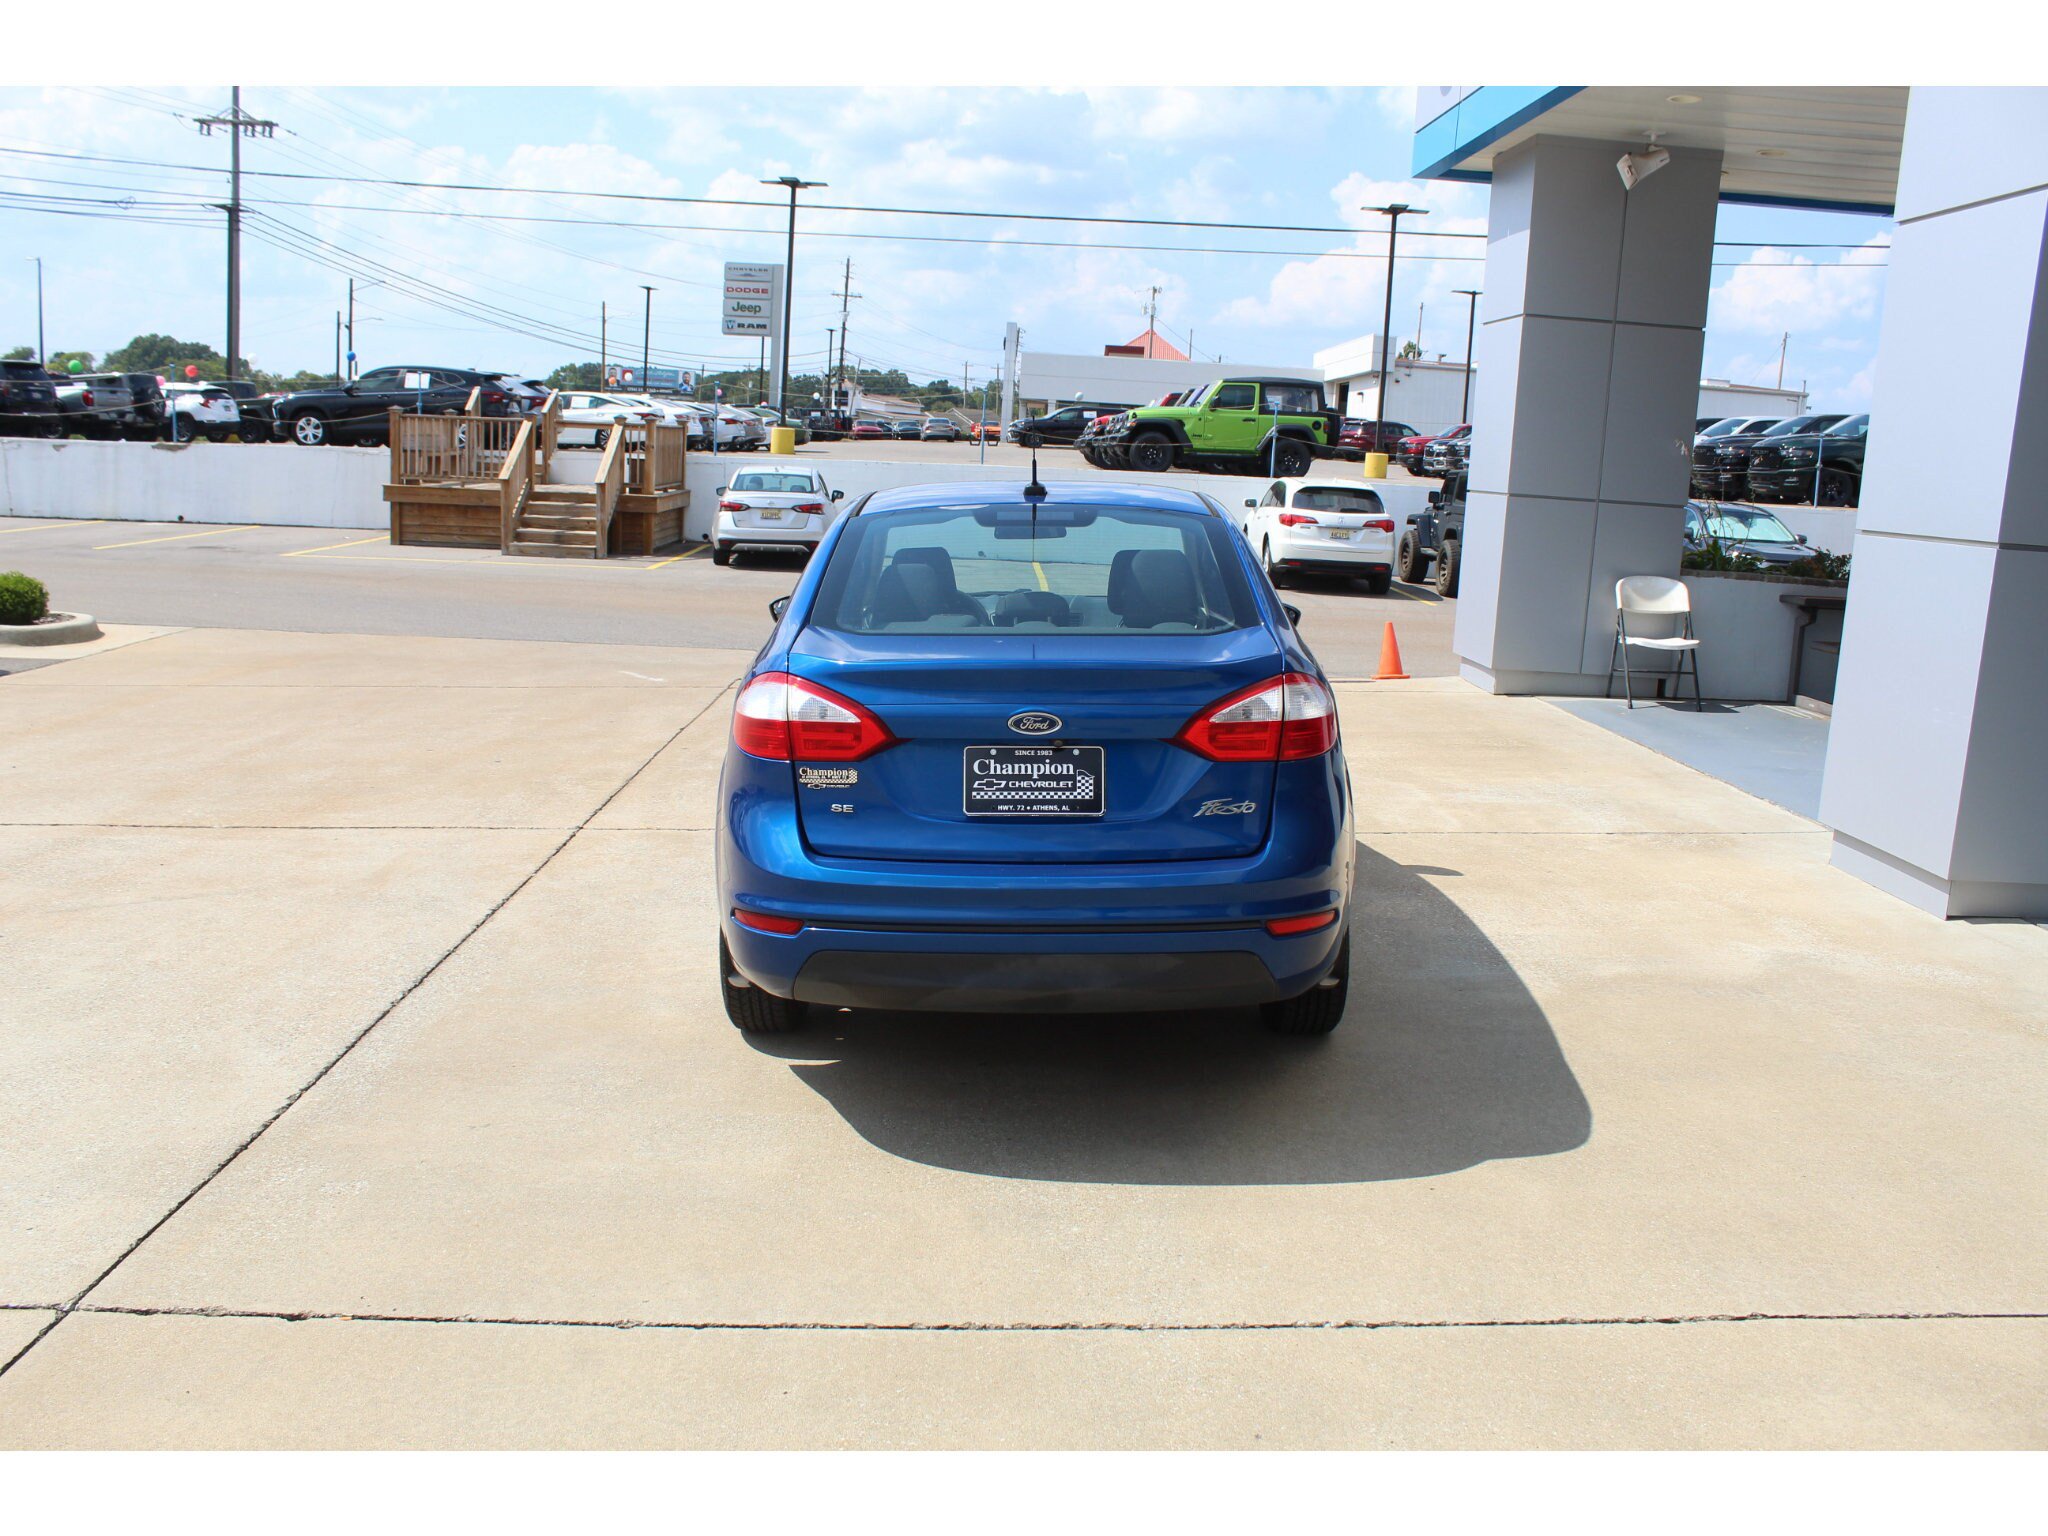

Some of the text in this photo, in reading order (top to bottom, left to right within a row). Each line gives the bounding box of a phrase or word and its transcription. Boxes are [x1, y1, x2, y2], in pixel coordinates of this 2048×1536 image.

[731, 301, 762, 315] Jeep
[1019, 716, 1050, 730] Ford
[799, 766, 849, 778] Champion
[972, 758, 1075, 779] Champion
[1008, 780, 1074, 788] CHEVROLET
[831, 803, 854, 813] SE
[1032, 804, 1060, 812] ATHENS,
[1192, 797, 1257, 818] Fiesta
